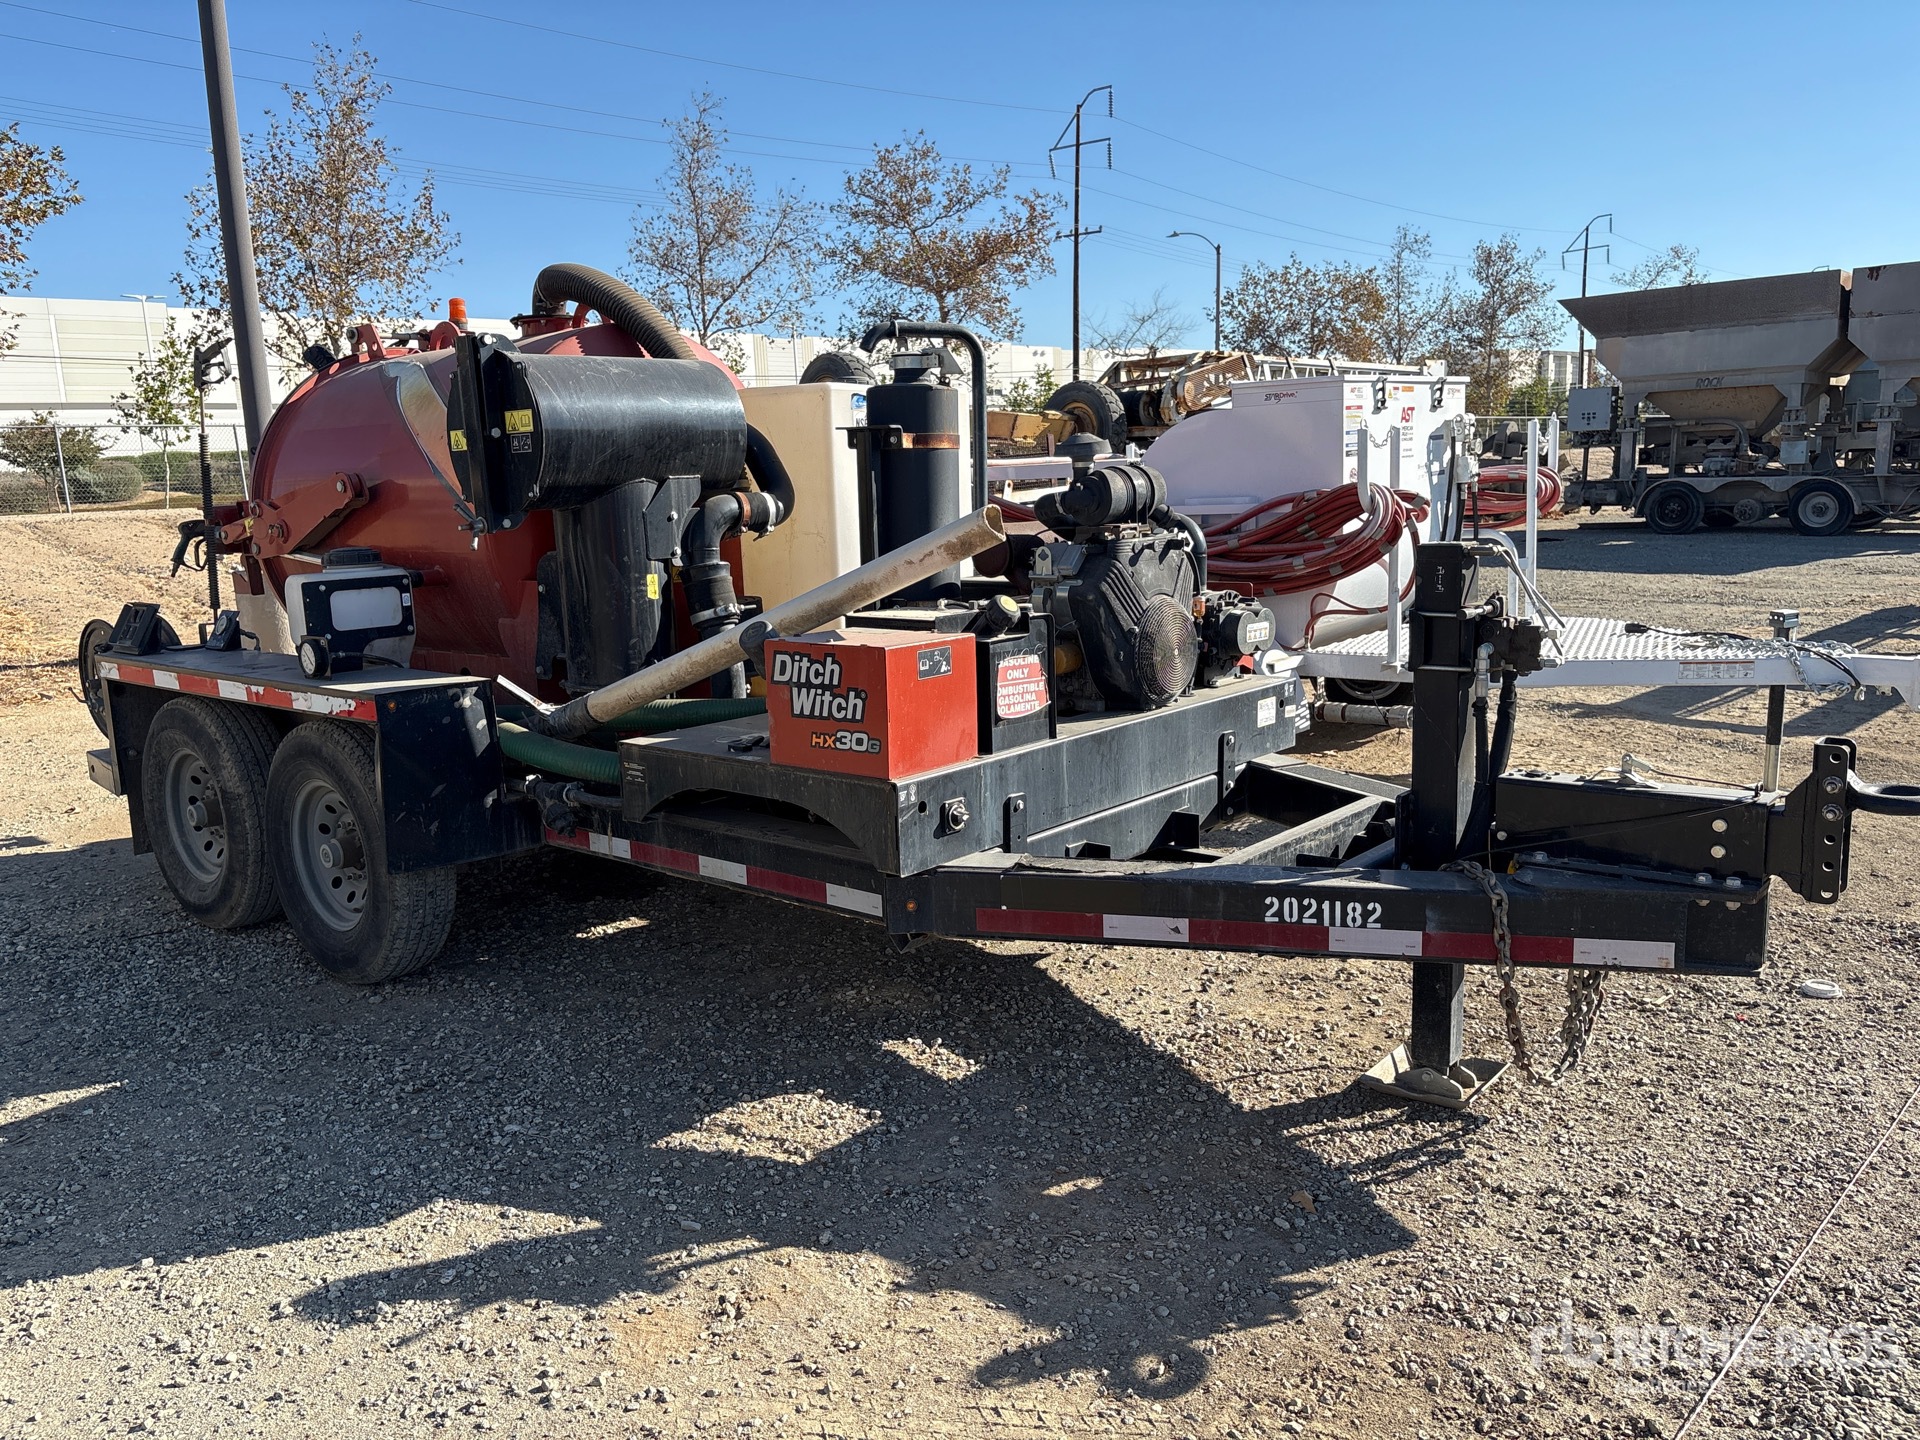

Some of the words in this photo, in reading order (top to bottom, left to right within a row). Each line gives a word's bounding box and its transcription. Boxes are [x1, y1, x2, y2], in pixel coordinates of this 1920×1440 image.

[1695, 376, 1726, 388] ROCK
[1400, 406, 1416, 424] AST
[773, 653, 841, 686] Ditch
[1006, 667, 1030, 680] ONLY
[997, 681, 1045, 697] OMBUSTIBLE
[998, 692, 1037, 705] GASOLINA
[998, 700, 1041, 715] OLAMENTE
[811, 731, 881, 753] HX30G
[1264, 896, 1382, 929] 2021182
